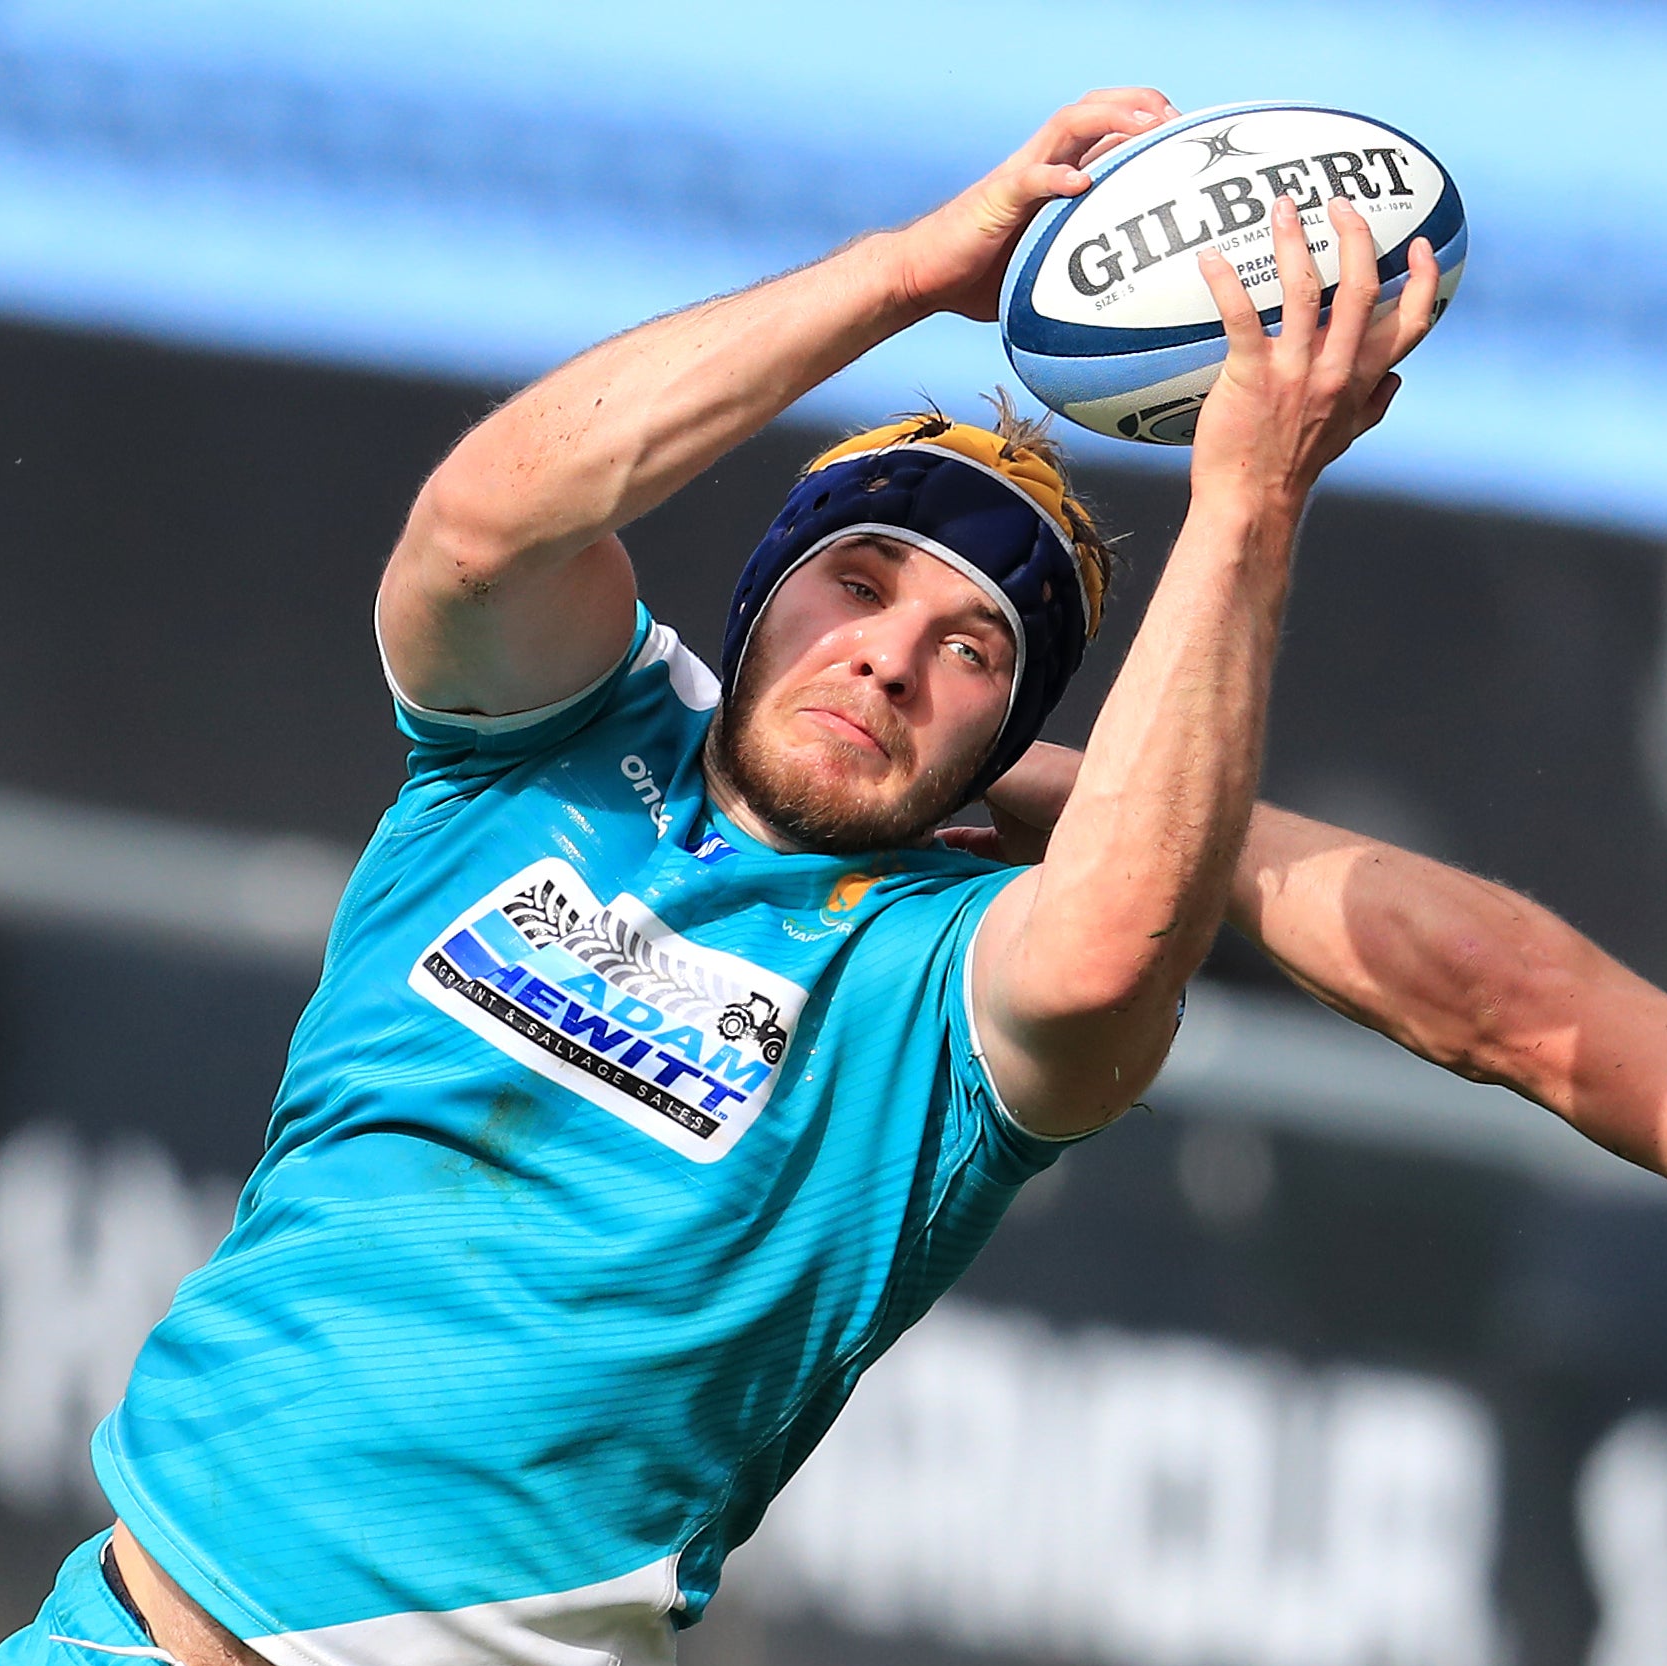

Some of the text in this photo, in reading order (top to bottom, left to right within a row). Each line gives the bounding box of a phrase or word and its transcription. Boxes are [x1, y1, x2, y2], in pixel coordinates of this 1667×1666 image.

[1068, 148, 1414, 297] GILBERT
[1299, 214, 1324, 226] ALL
[1095, 290, 1120, 311] SIZE
[484, 964, 747, 1112] HEWITT
[504, 1008, 516, 1023] &
[526, 1022, 625, 1085] SALVAGE
[636, 1084, 704, 1131] SALES
[558, 972, 772, 1093] ADAM
[712, 1108, 729, 1121] LTD
